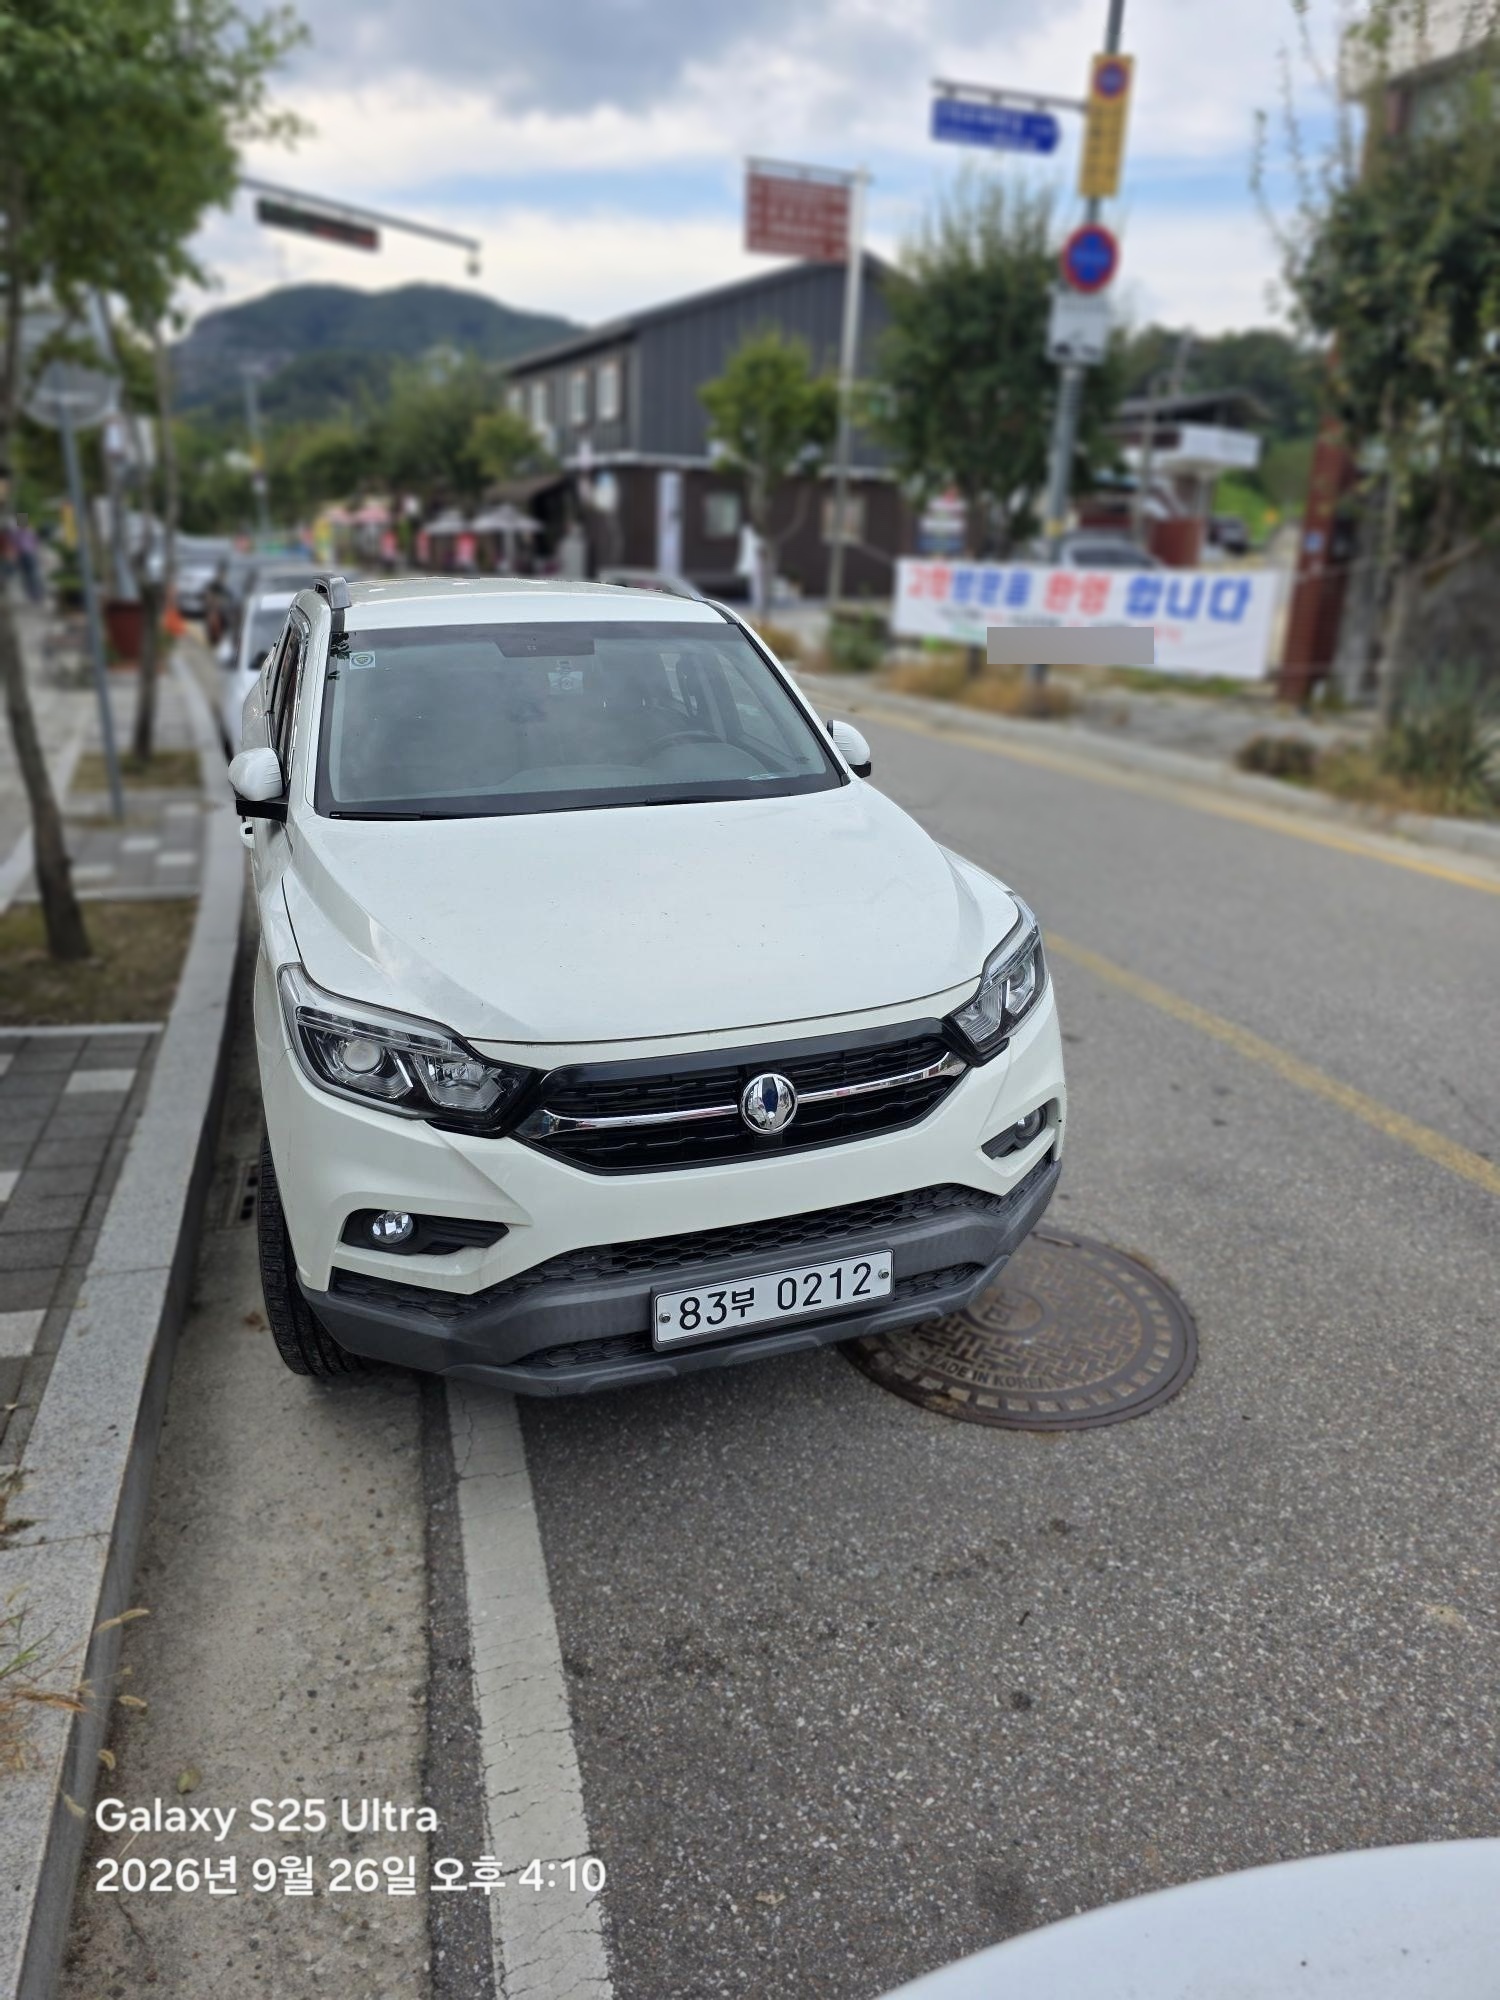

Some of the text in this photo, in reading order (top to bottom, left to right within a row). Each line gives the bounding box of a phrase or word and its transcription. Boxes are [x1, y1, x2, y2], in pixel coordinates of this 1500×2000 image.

[1126, 575, 1252, 624] 합니다
[679, 1262, 871, 1331] 83부 0212
